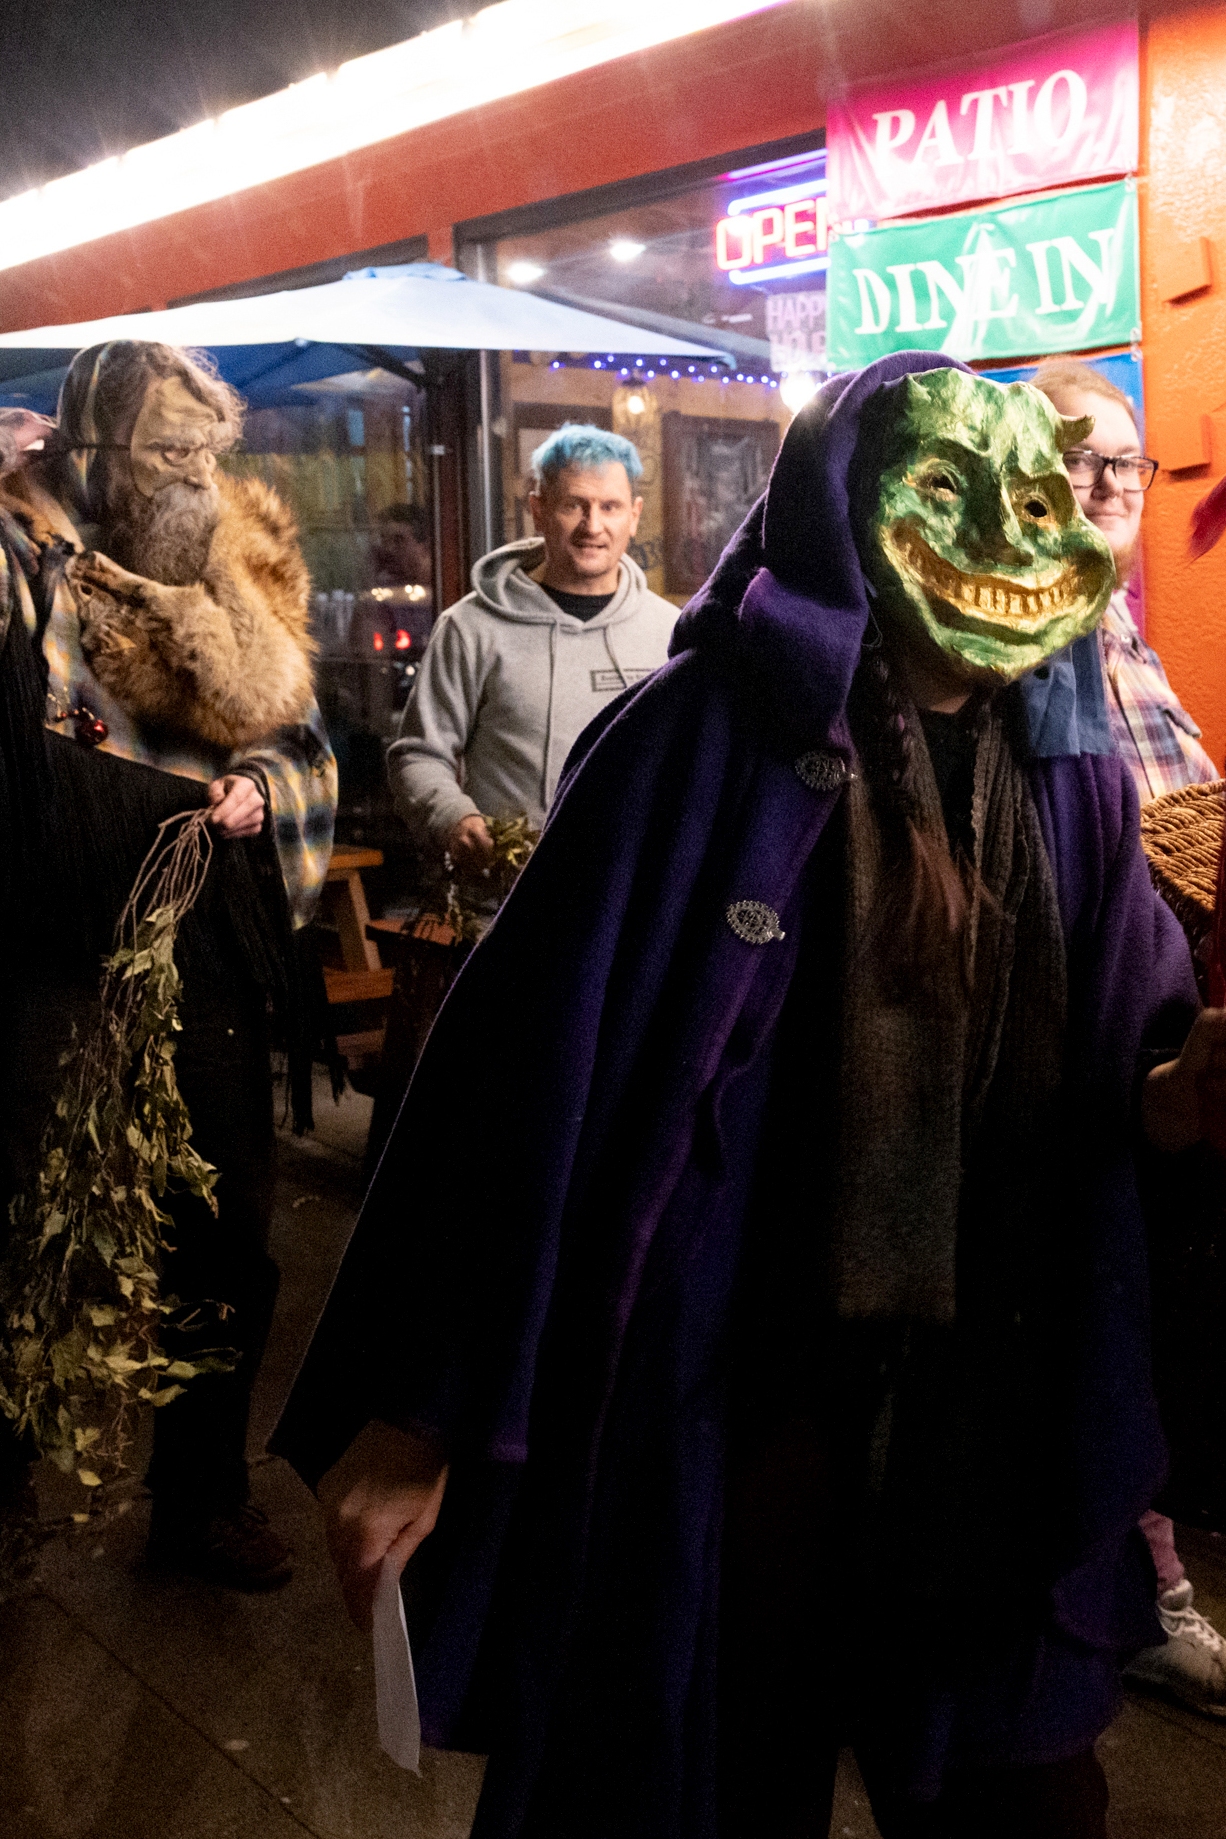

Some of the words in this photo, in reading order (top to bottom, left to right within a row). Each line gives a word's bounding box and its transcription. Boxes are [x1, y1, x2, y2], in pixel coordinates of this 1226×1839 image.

[872, 69, 1087, 168] PATIO
[853, 249, 1019, 334] DINE
[1026, 228, 1115, 316] IN
